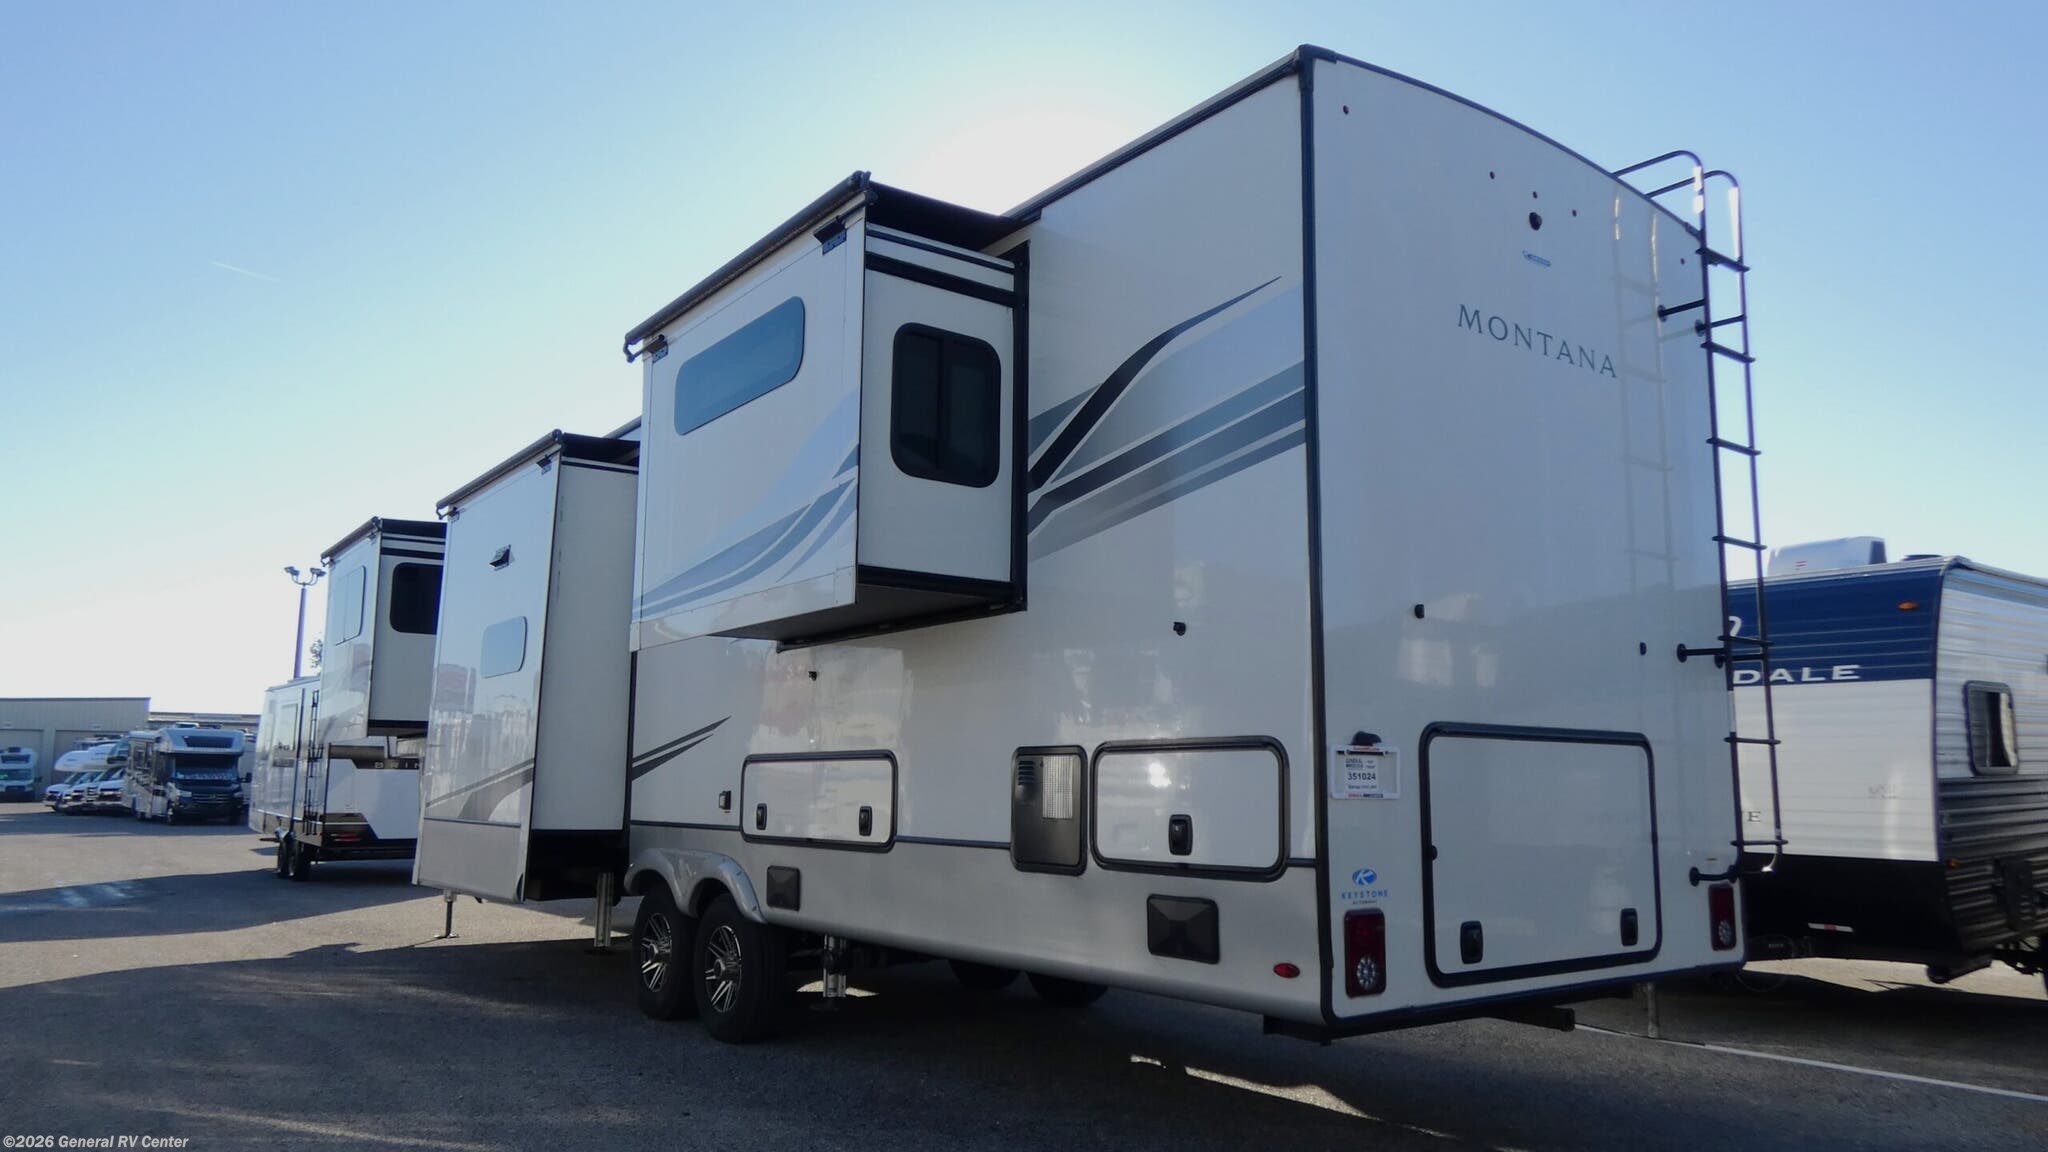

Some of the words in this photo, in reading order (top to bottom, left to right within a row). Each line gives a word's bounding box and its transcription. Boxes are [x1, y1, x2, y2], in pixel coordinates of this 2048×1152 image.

[1457, 303, 1617, 378] MONTANA
[1732, 664, 1861, 685] DALE
[1347, 772, 1377, 781] 351024
[1341, 889, 1389, 900] KEYSTONE
